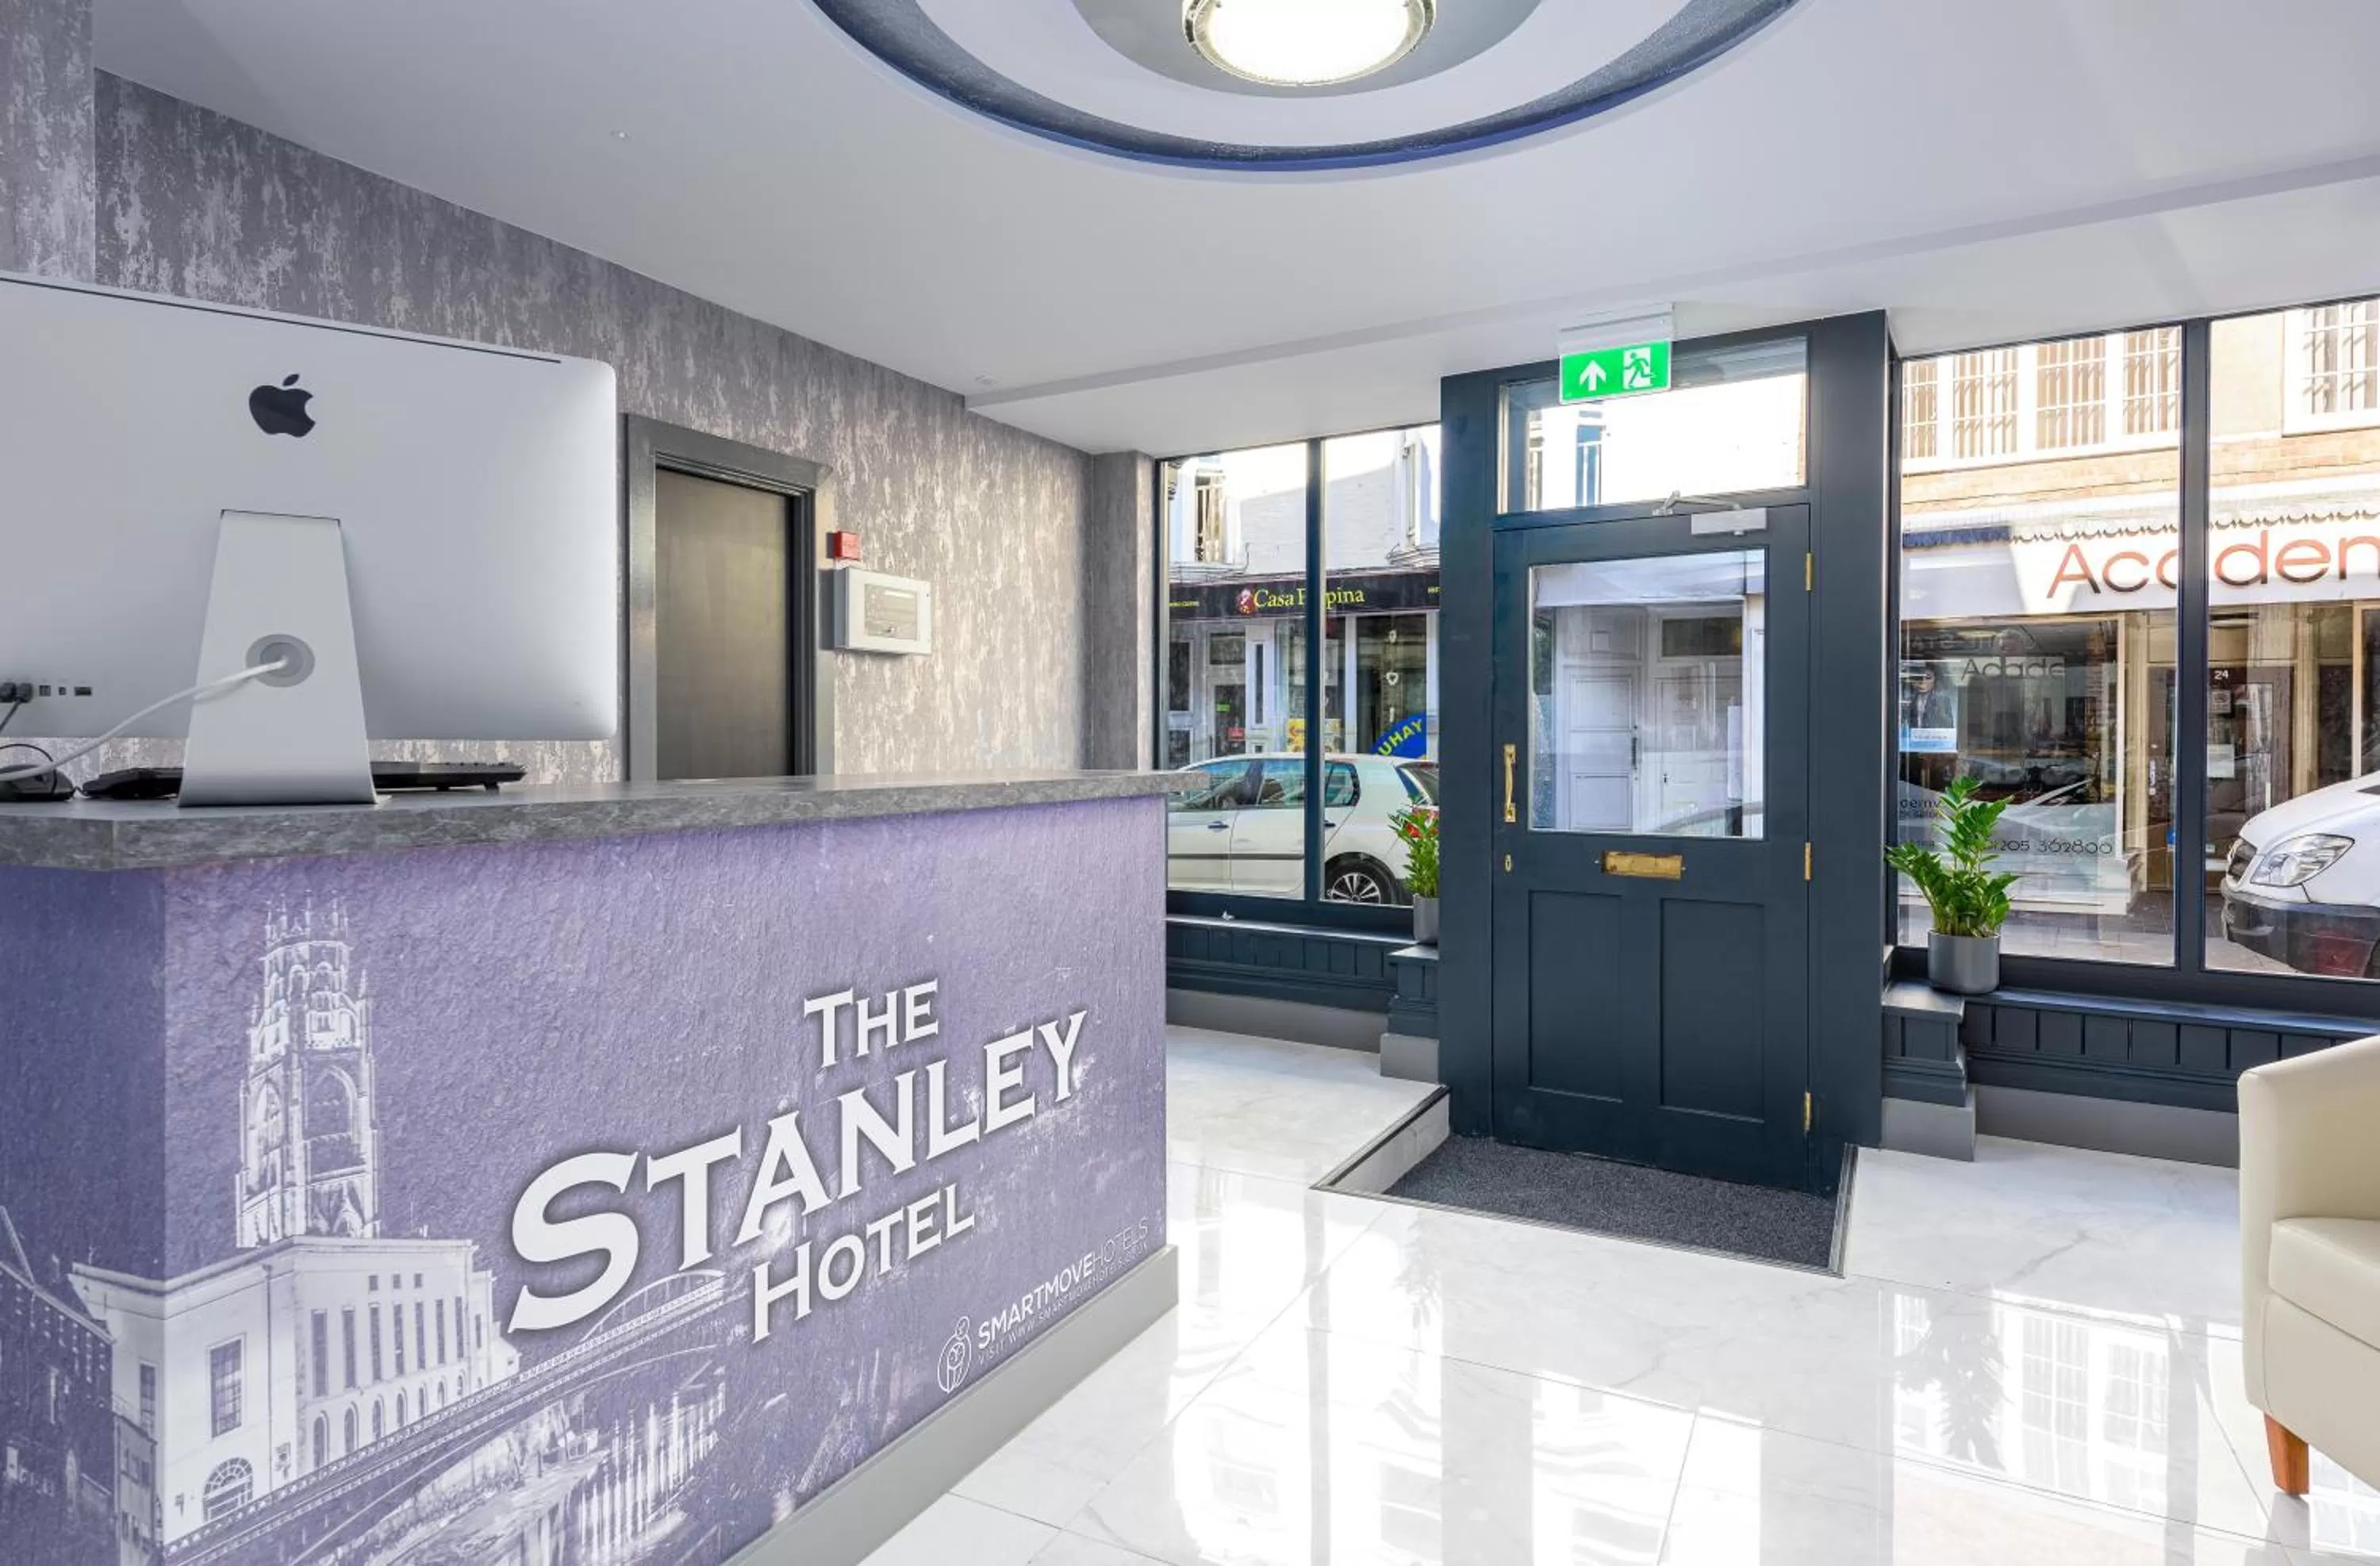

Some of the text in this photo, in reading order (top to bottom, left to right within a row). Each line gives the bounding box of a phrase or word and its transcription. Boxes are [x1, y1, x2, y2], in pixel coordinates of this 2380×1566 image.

[1253, 586, 1365, 610] Casa Fpina
[2214, 670, 2228, 680] 24
[804, 977, 939, 1069] THE
[508, 1010, 1089, 1334] STANLEY
[752, 1183, 975, 1344] HOTEL
